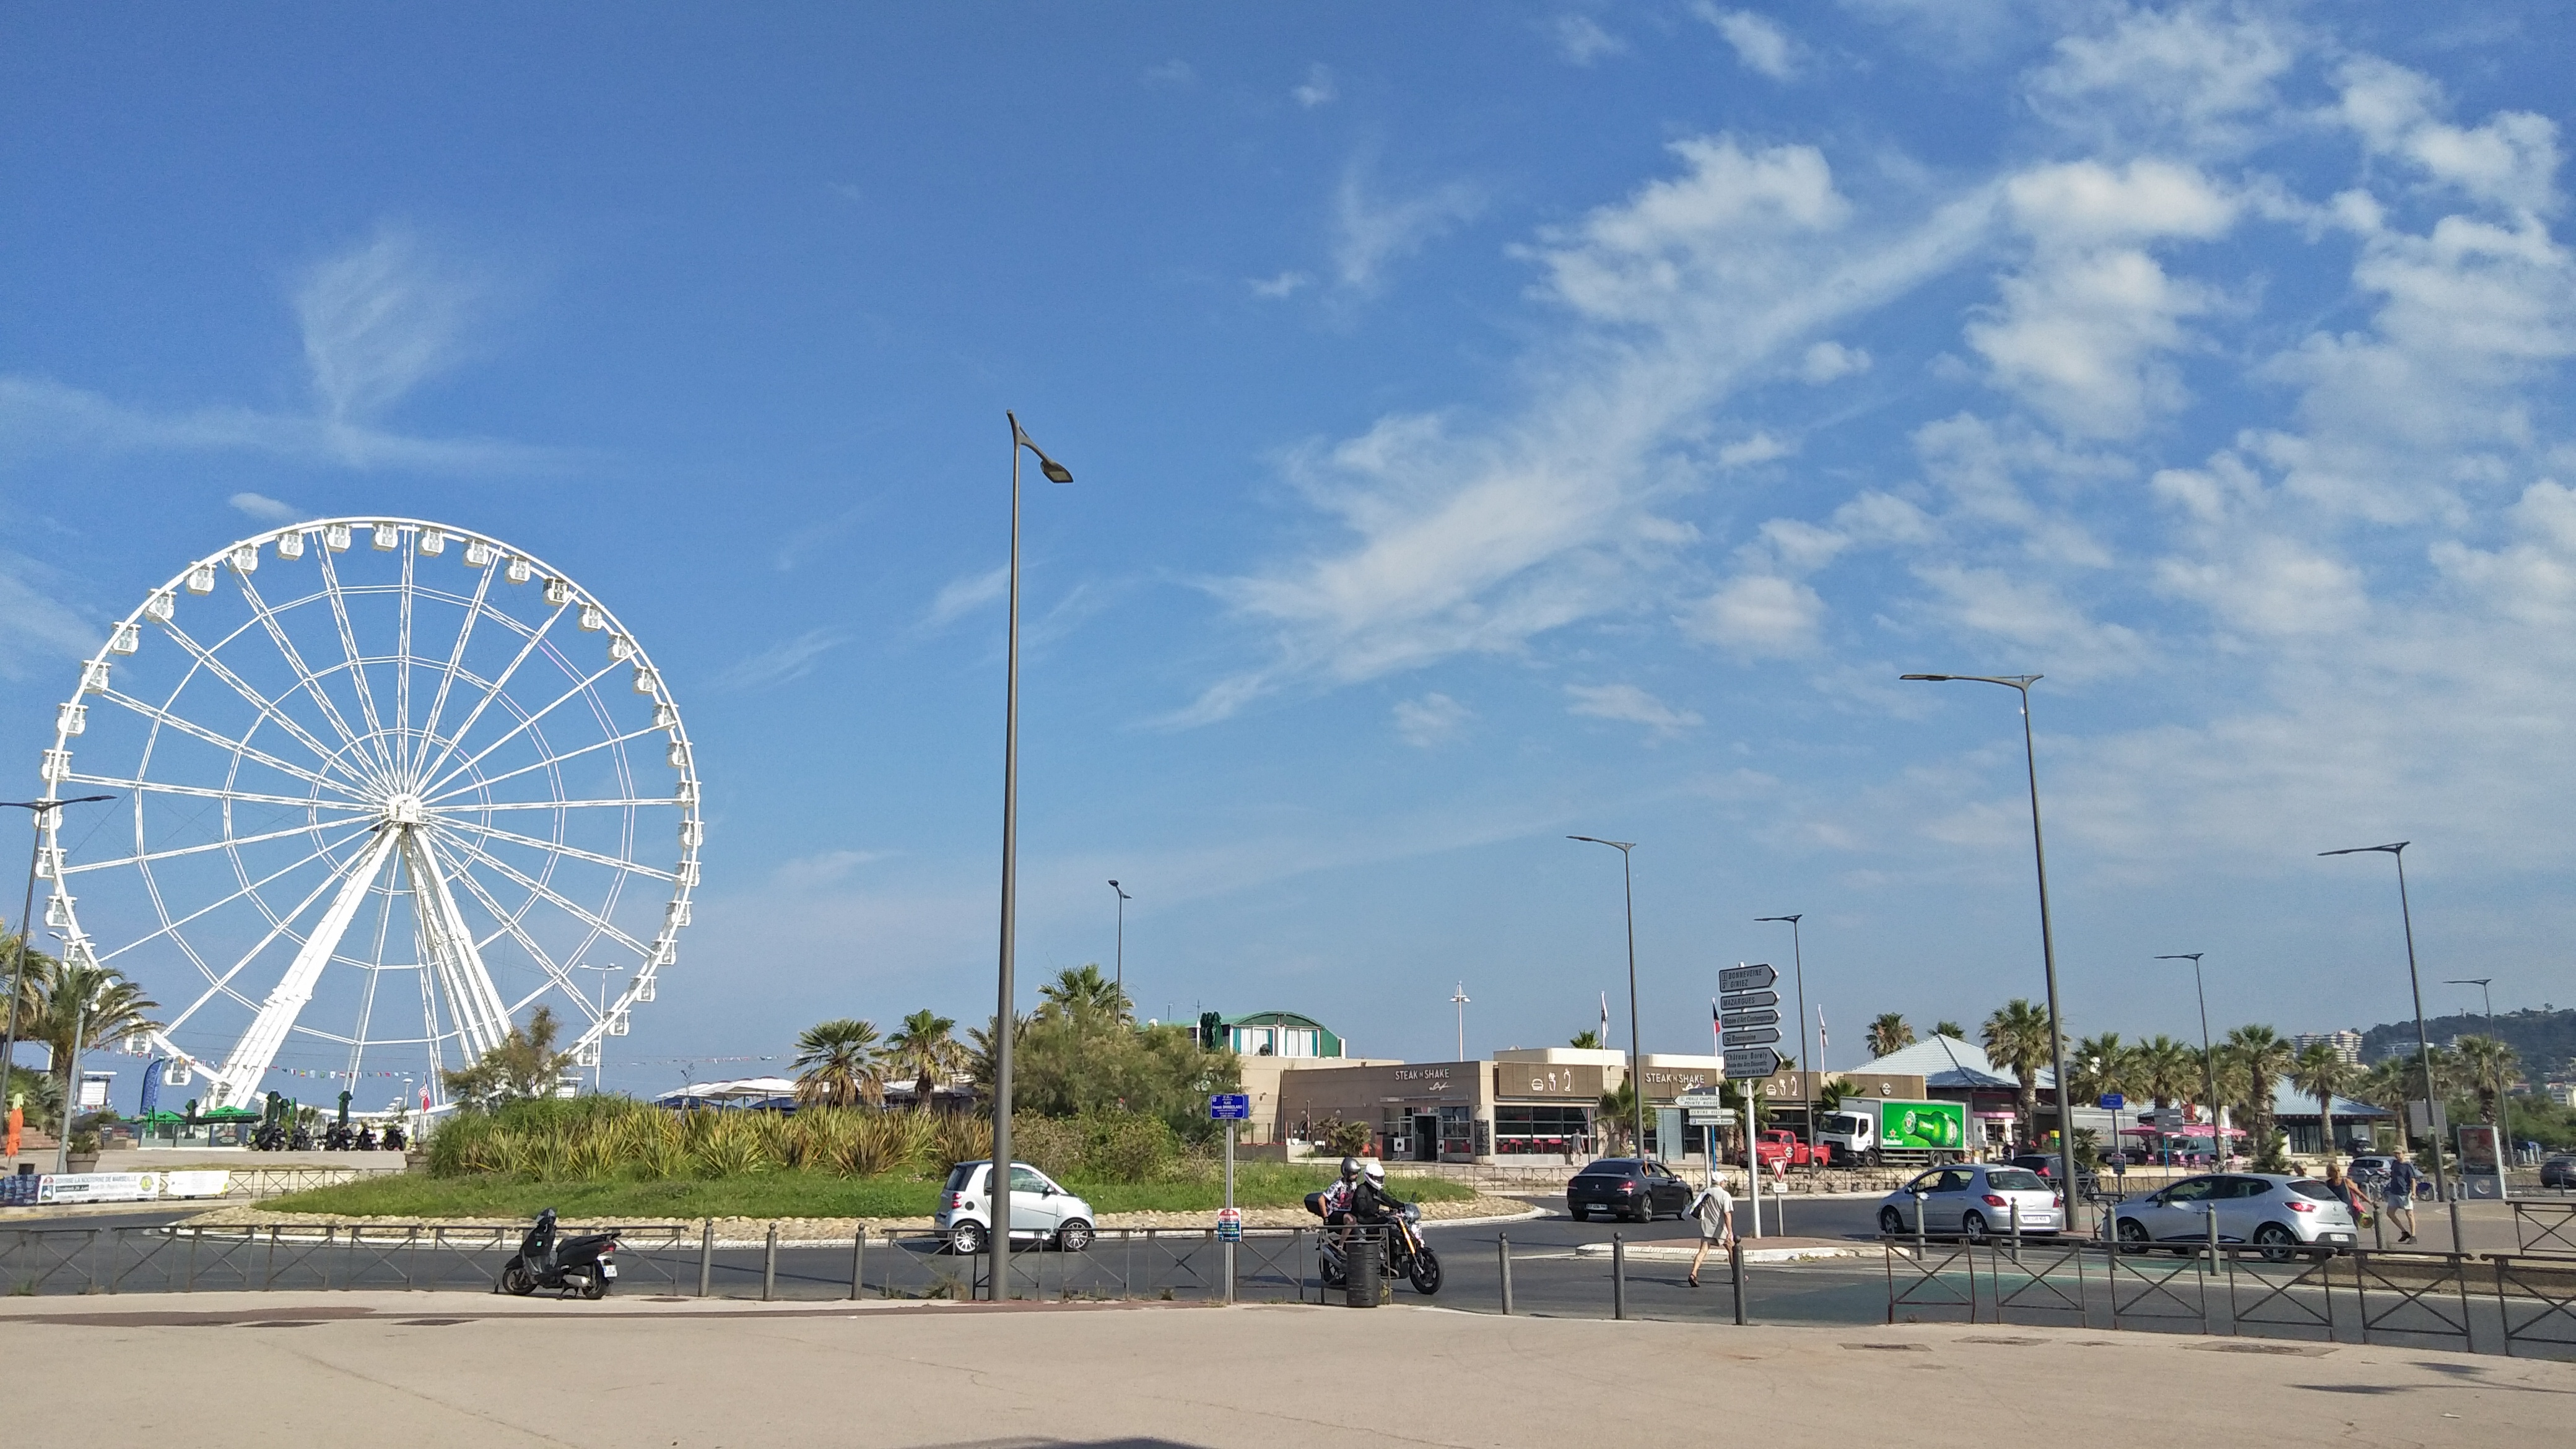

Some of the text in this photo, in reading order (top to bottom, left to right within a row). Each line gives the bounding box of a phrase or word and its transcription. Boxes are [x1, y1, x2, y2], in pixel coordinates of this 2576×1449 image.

[1728, 968, 1762, 980] BONNEVEINE
[1730, 979, 1748, 988] GINIEZ
[1723, 997, 1755, 1006] MAZARGUES
[1395, 1070, 1418, 1081] STEAK
[1424, 1068, 1450, 1079] SHAKE
[1645, 1073, 1671, 1083] STEAK
[1678, 1074, 1705, 1084] SHAKE
